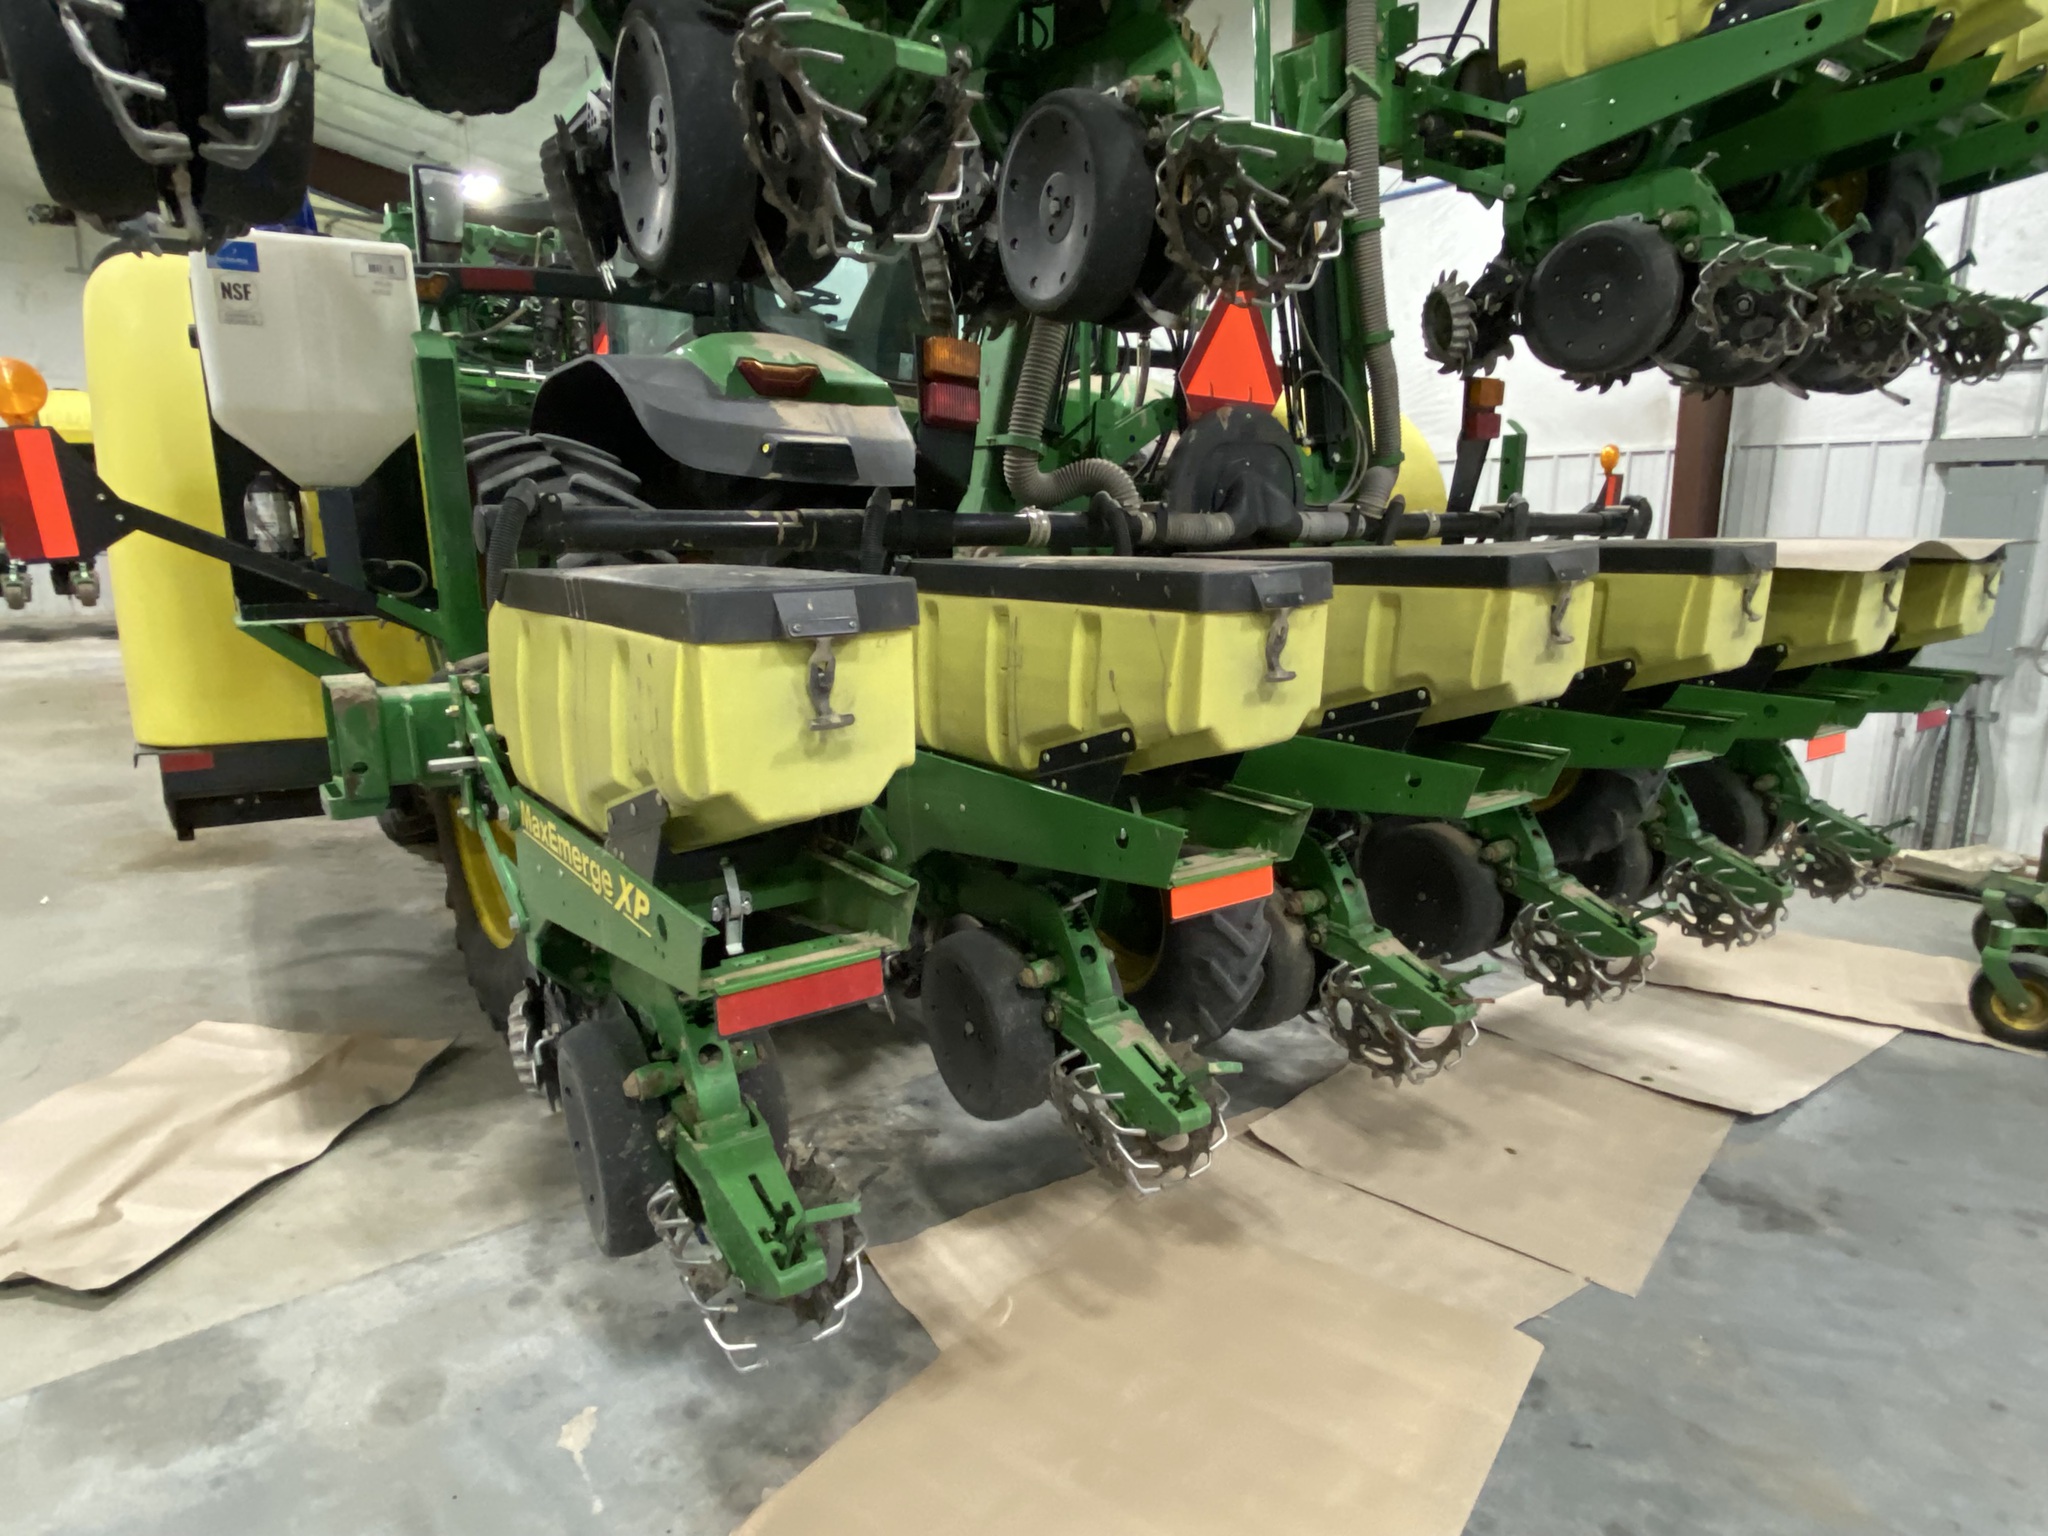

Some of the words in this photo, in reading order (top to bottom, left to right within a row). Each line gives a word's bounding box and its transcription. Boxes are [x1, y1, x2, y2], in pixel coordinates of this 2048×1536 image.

[220, 281, 252, 301] NSF
[520, 800, 613, 896] MaxEmerge
[614, 875, 650, 920] XP
